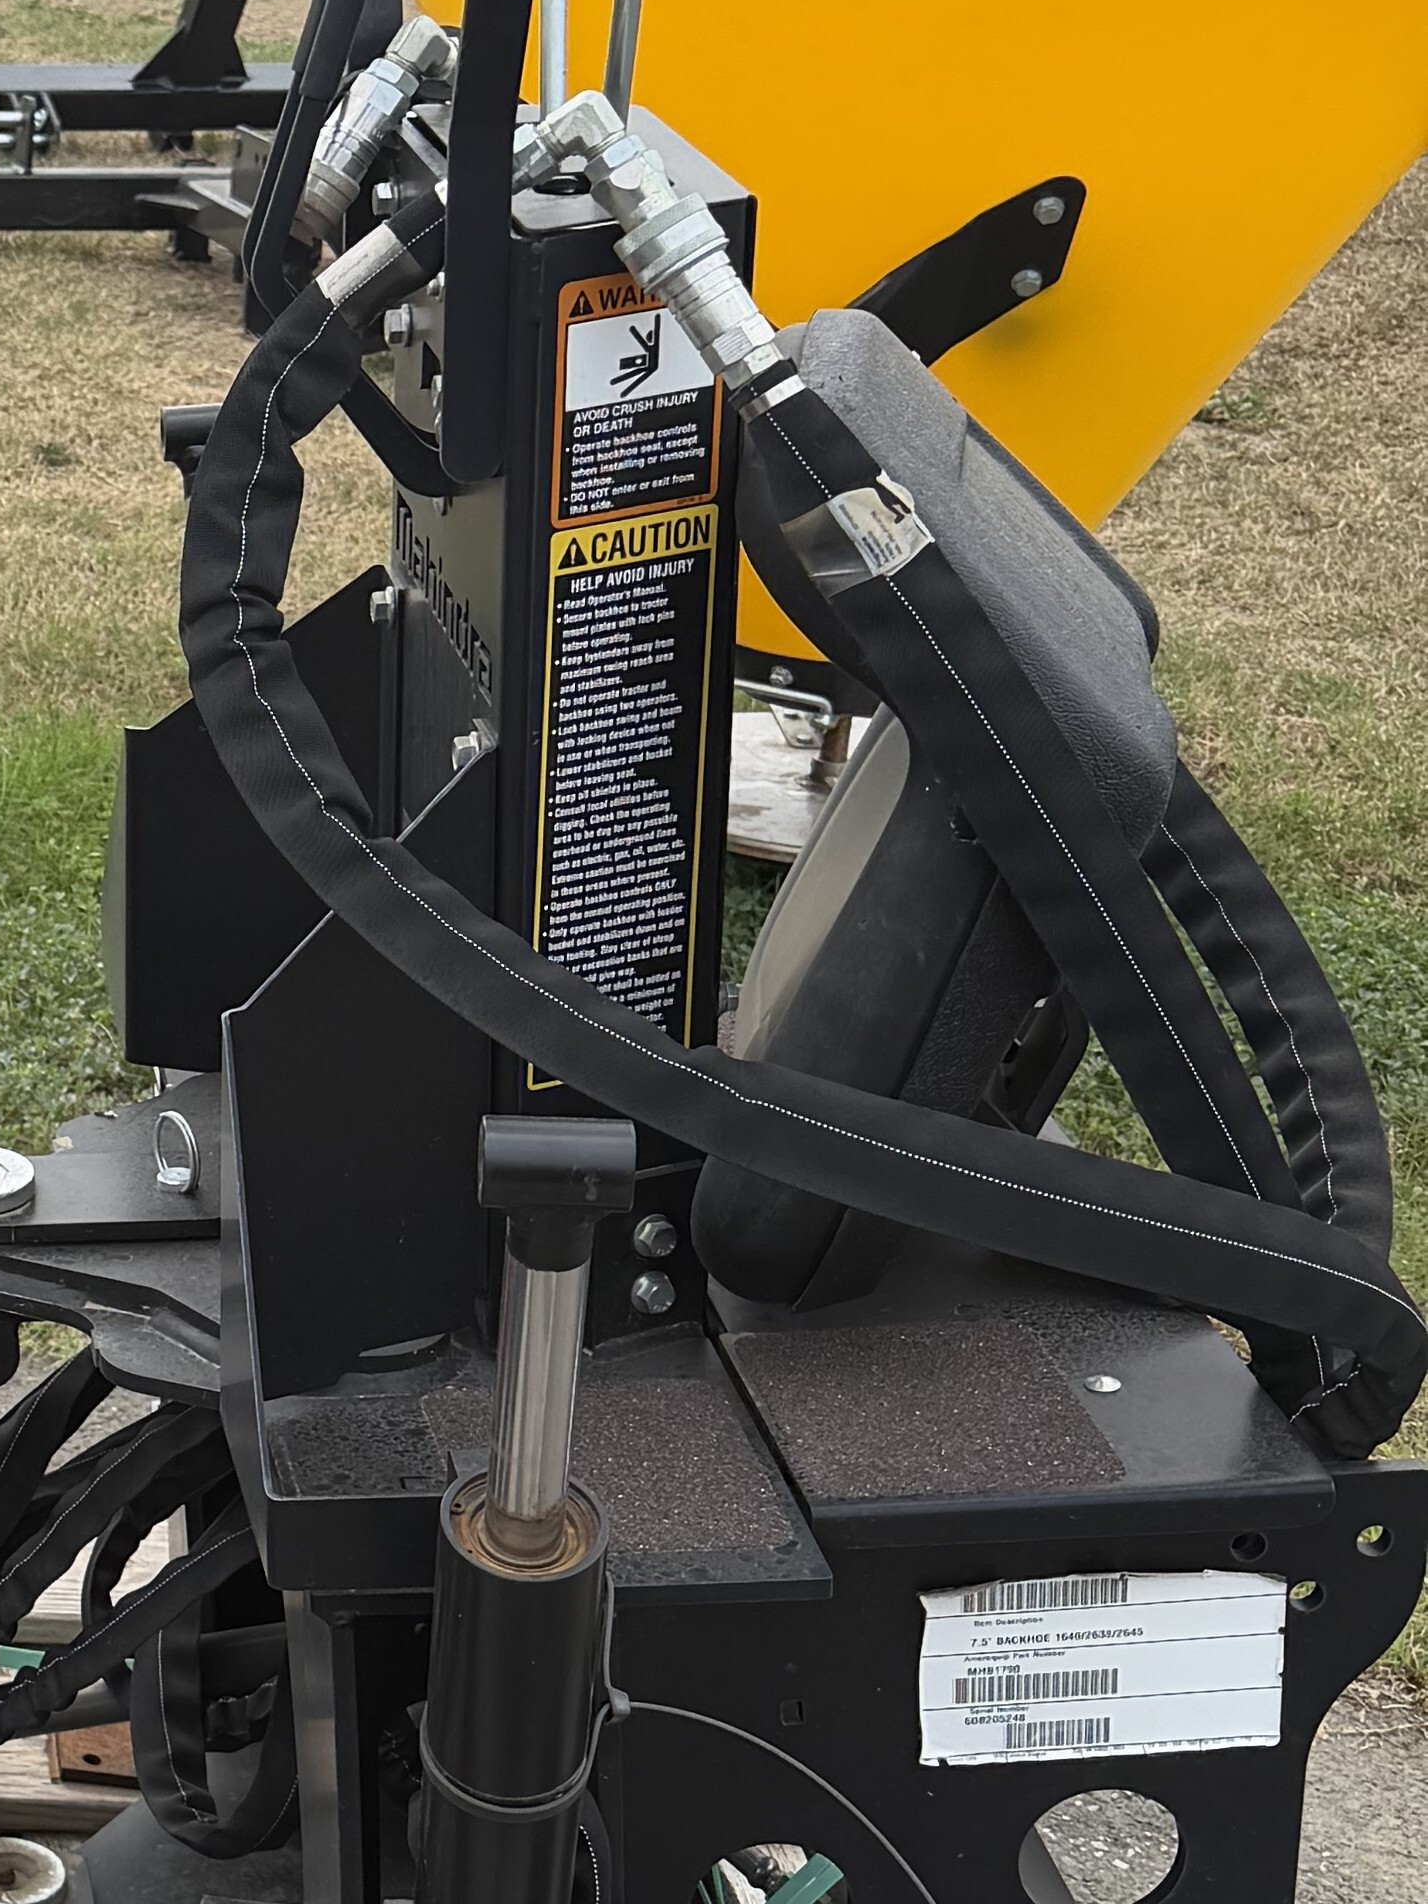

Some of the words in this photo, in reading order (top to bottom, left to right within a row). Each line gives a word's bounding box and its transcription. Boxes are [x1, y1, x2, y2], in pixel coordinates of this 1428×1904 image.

[573, 407, 609, 423] AVOID
[611, 399, 653, 416] CRUSH
[656, 391, 698, 408] INJURY
[573, 424, 590, 437] OR
[593, 416, 632, 434] DEATH
[572, 439, 611, 454] Operate
[657, 422, 696, 437] controls
[572, 453, 594, 466] from
[647, 455, 657, 464] or
[659, 447, 705, 462] removing
[570, 491, 585, 502] DO
[588, 487, 609, 499] NOT
[611, 483, 636, 495] enter
[639, 481, 650, 489] or
[651, 476, 669, 487] exit
[672, 473, 694, 483] from
[569, 504, 587, 514] this
[590, 514, 710, 563] CAUTION
[571, 574, 603, 593] HELP
[606, 566, 644, 586] AVOID
[648, 558, 693, 579] INJURY
[563, 597, 585, 609] Read
[996, 1633, 1049, 1645] BACKHOE
